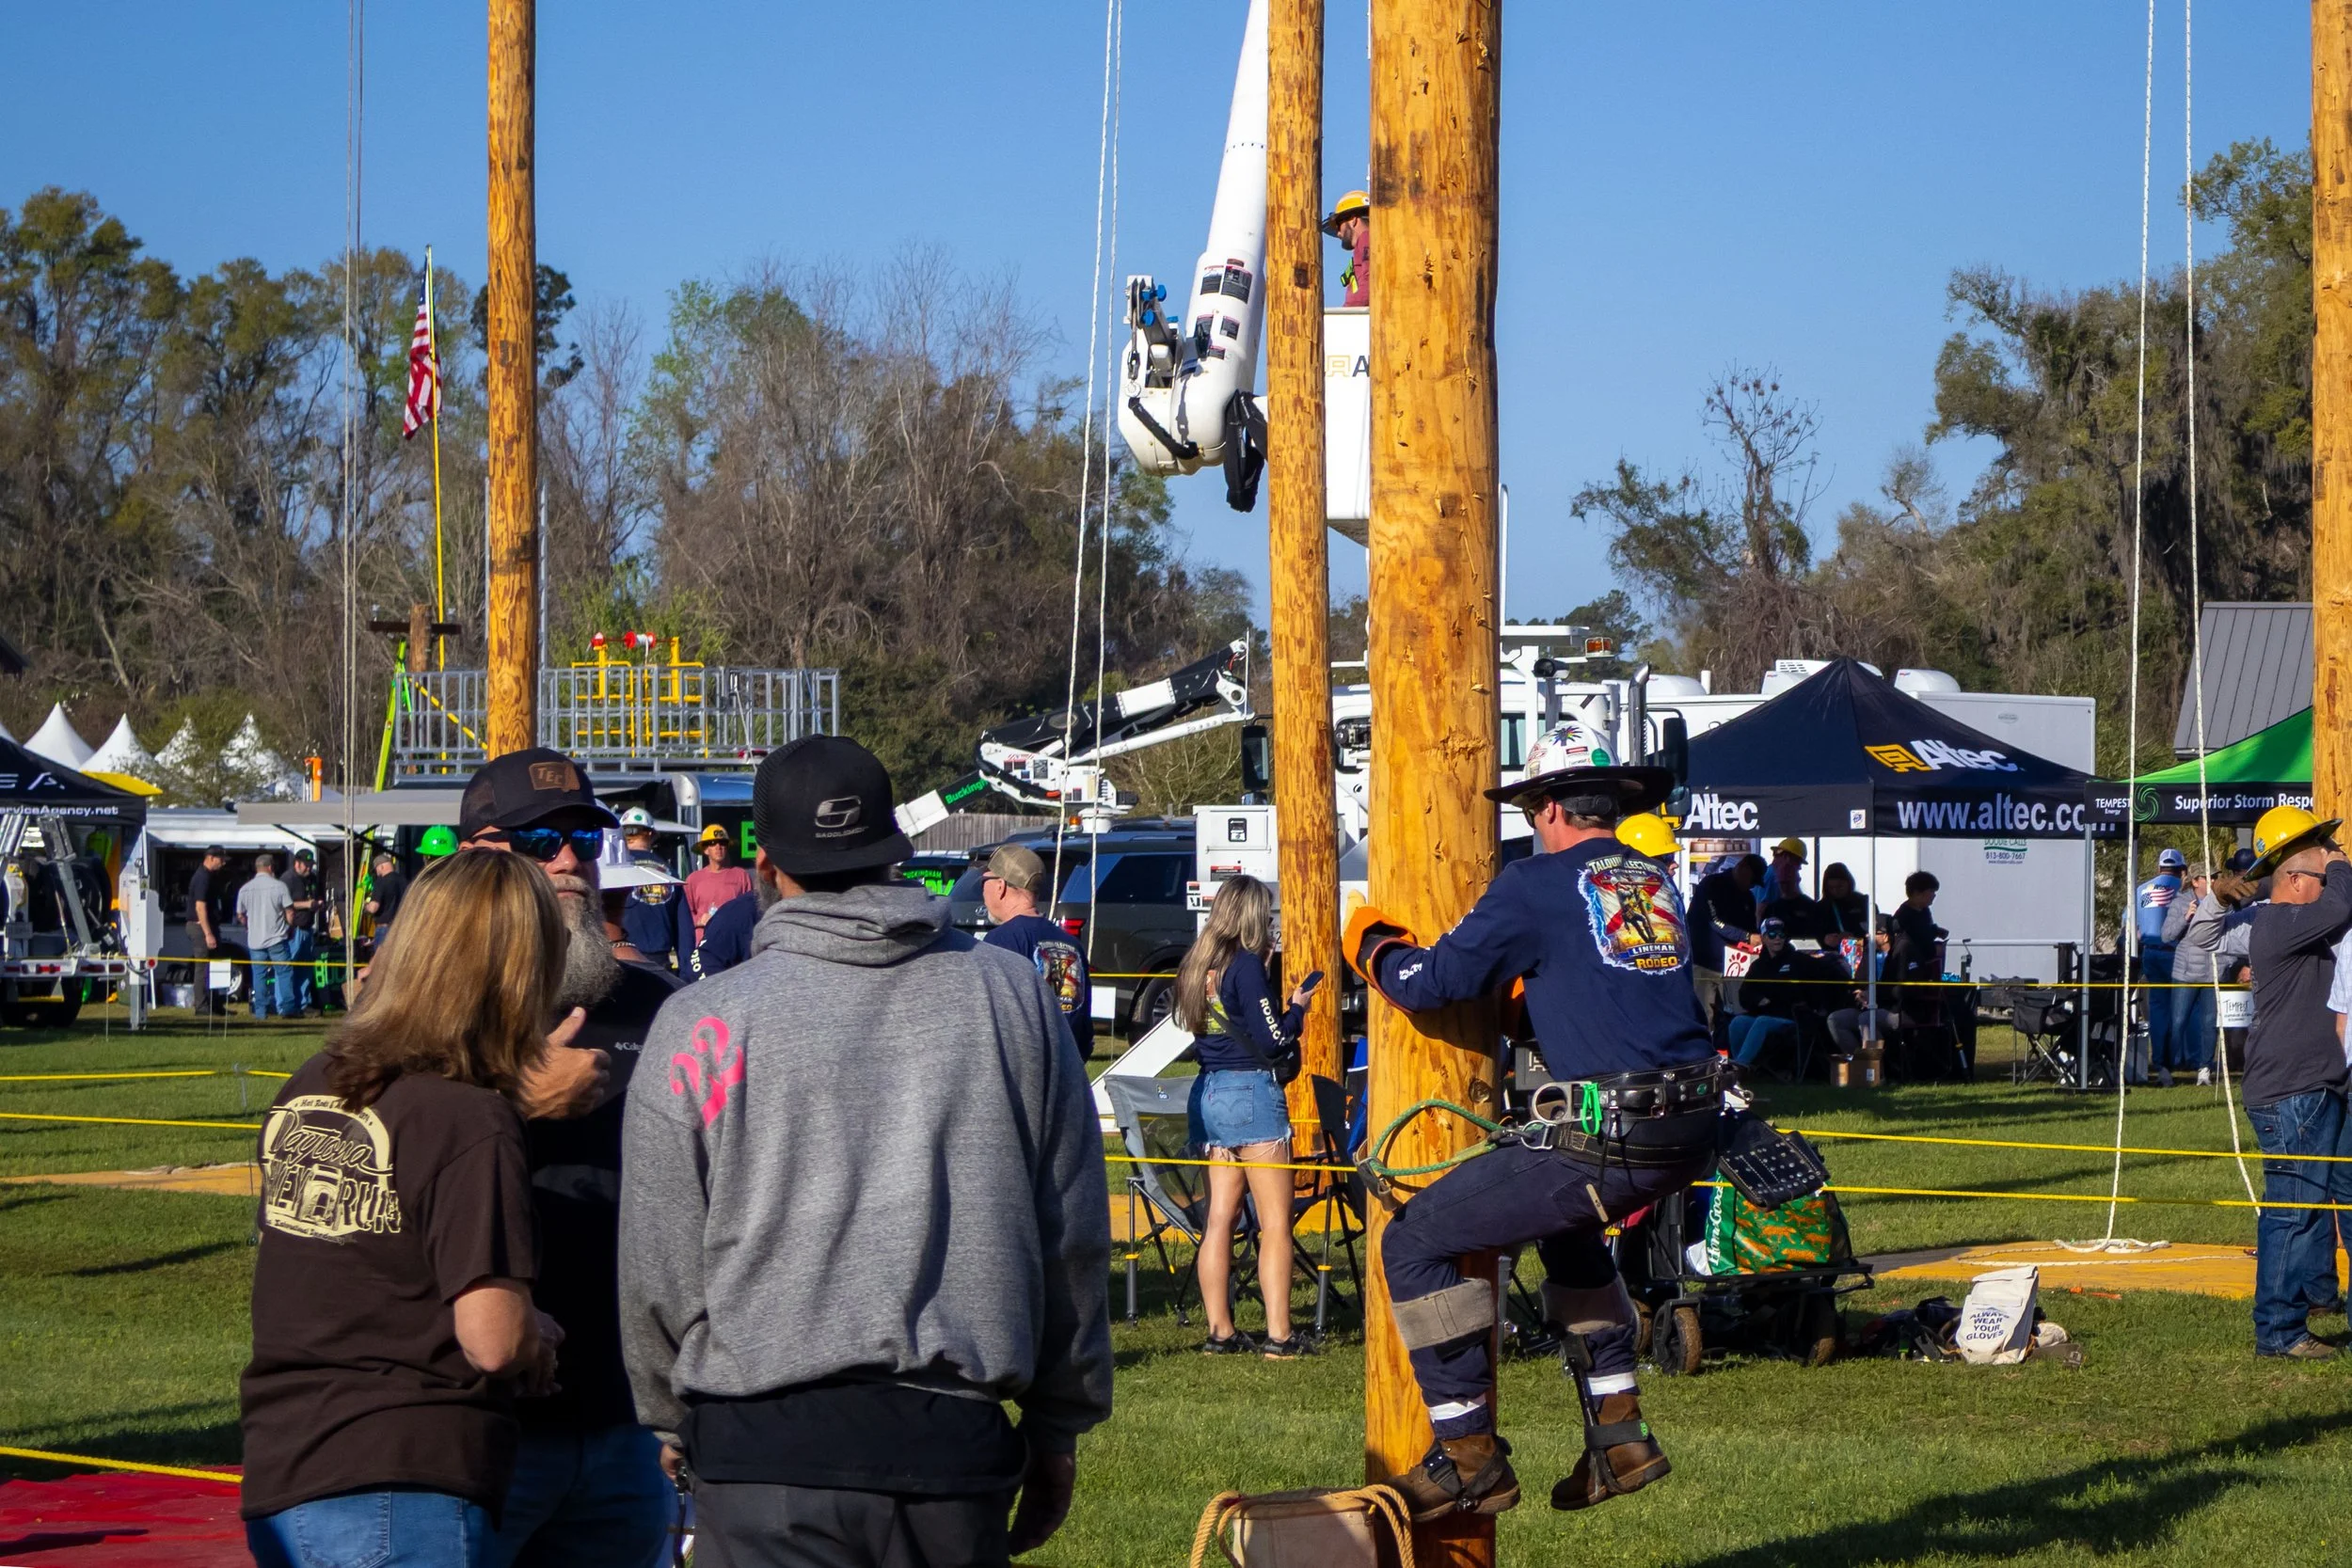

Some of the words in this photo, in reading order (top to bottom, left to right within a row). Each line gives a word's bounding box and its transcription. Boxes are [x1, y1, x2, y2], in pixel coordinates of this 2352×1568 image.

[2234, 795, 2275, 809] Storm
[1897, 793, 2116, 832] www.altec.co
[1632, 944, 1676, 955] LINEMAN
[1635, 956, 1678, 969] RODEO
[1260, 997, 1281, 1040] RODEO
[1966, 1329, 2005, 1340] GLOVES
